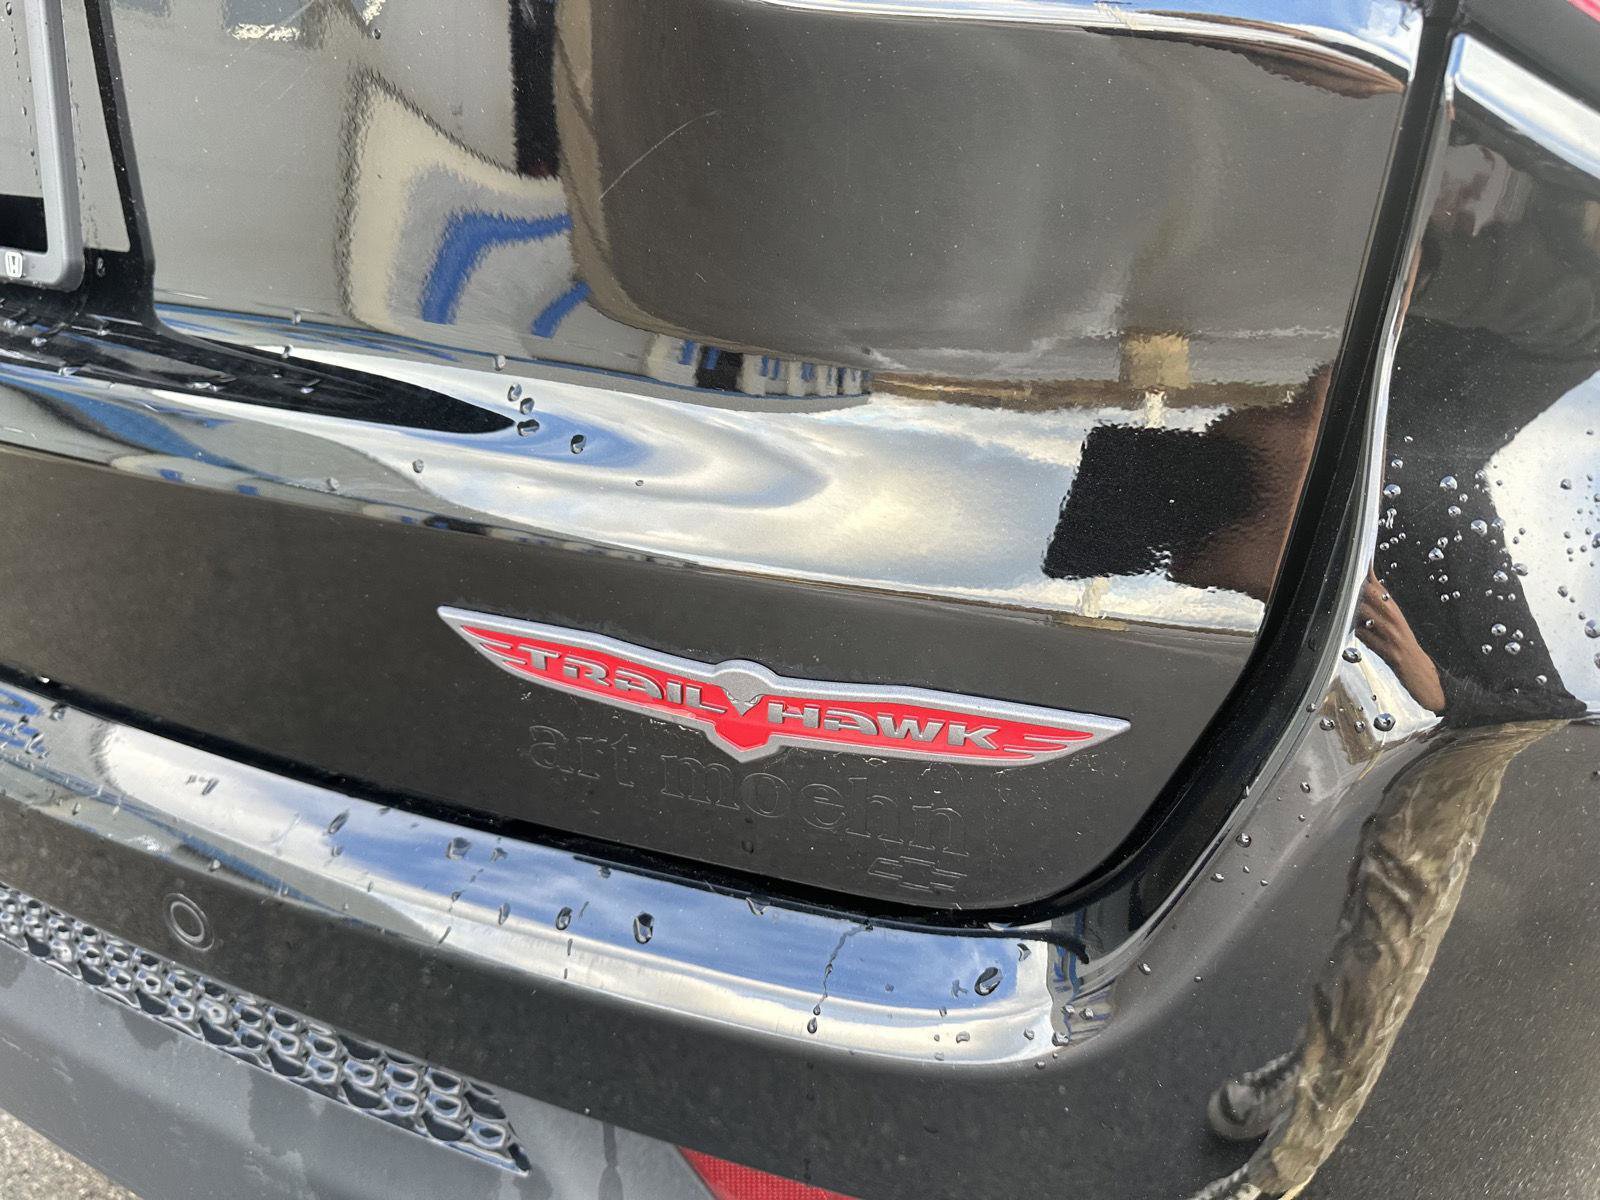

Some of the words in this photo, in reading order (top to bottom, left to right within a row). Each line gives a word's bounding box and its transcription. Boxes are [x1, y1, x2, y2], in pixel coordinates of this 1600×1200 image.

[521, 646, 727, 713] TRAIL
[769, 703, 1002, 751] HAWK
[528, 725, 636, 788] art
